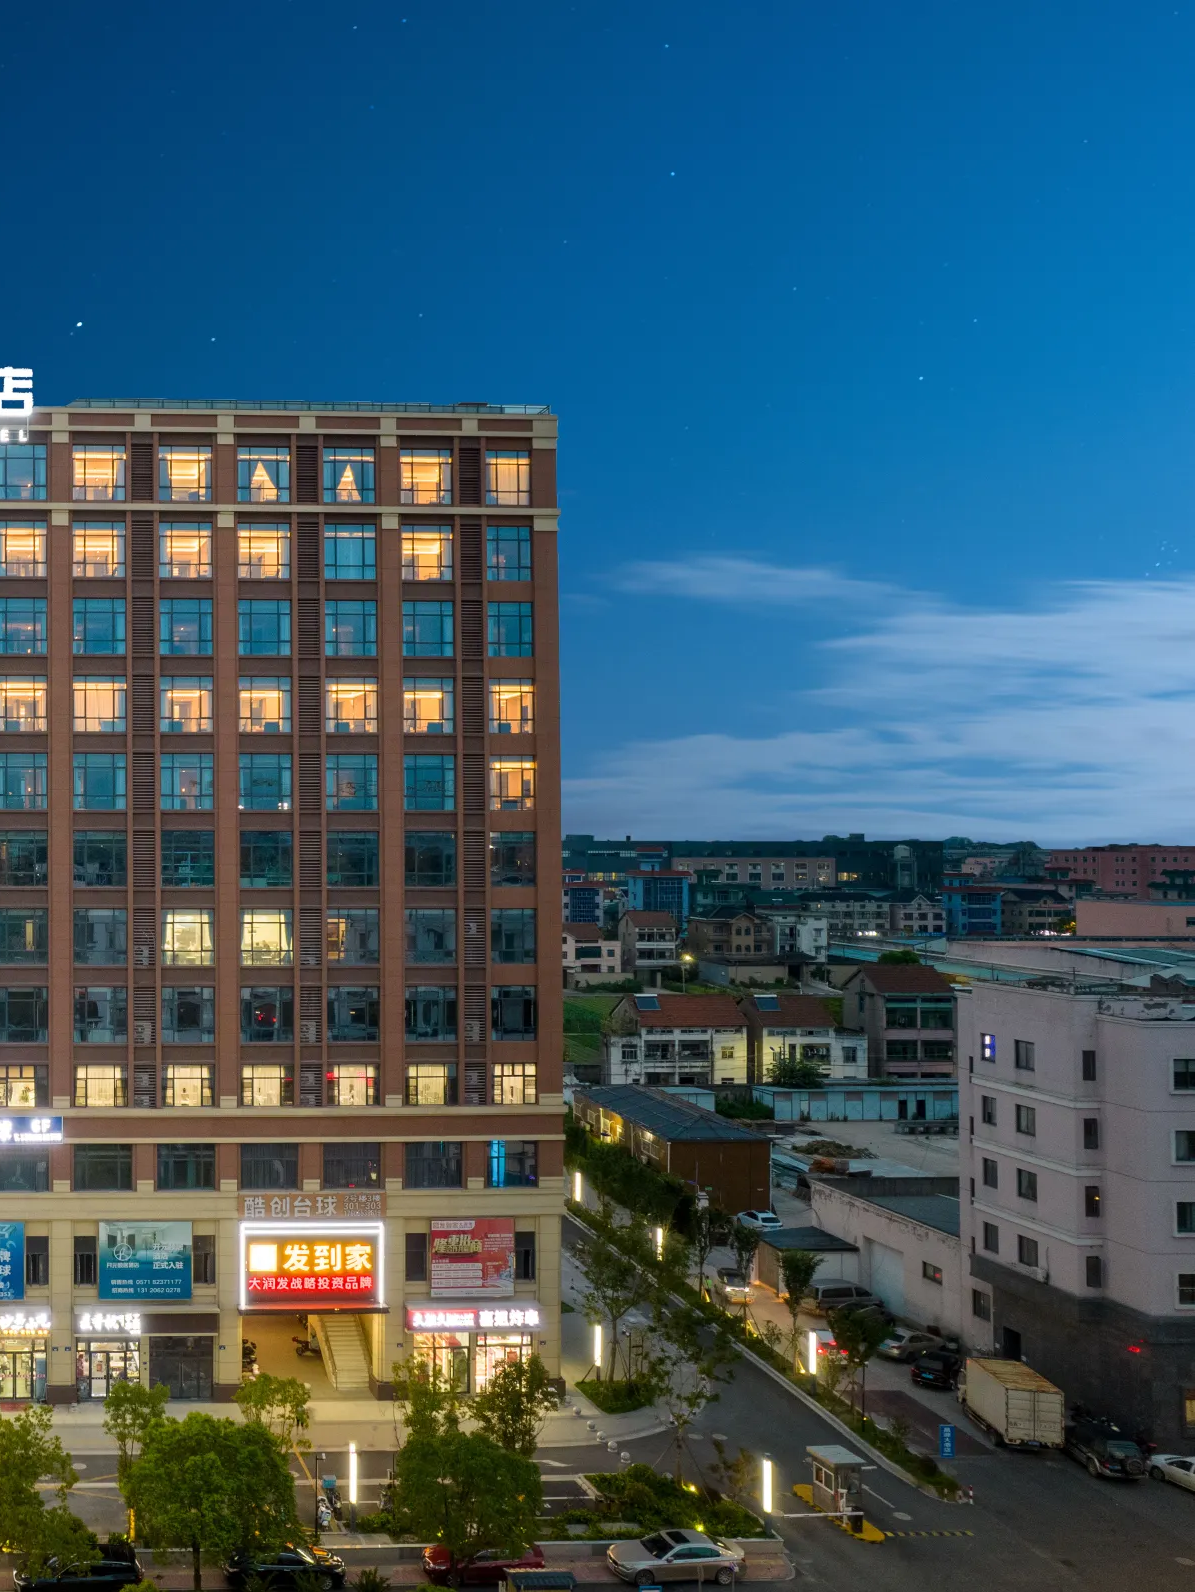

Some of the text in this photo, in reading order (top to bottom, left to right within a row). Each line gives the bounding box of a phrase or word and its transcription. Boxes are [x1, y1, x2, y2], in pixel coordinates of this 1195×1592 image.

[30, 1118, 51, 1133] 6F
[244, 1196, 337, 1218] 酷创台球
[344, 1202, 381, 1210] 301-303
[283, 1244, 372, 1271] 发到家
[152, 1261, 184, 1269] 正式入驻
[248, 1276, 373, 1290] 大润发战略投资品牌
